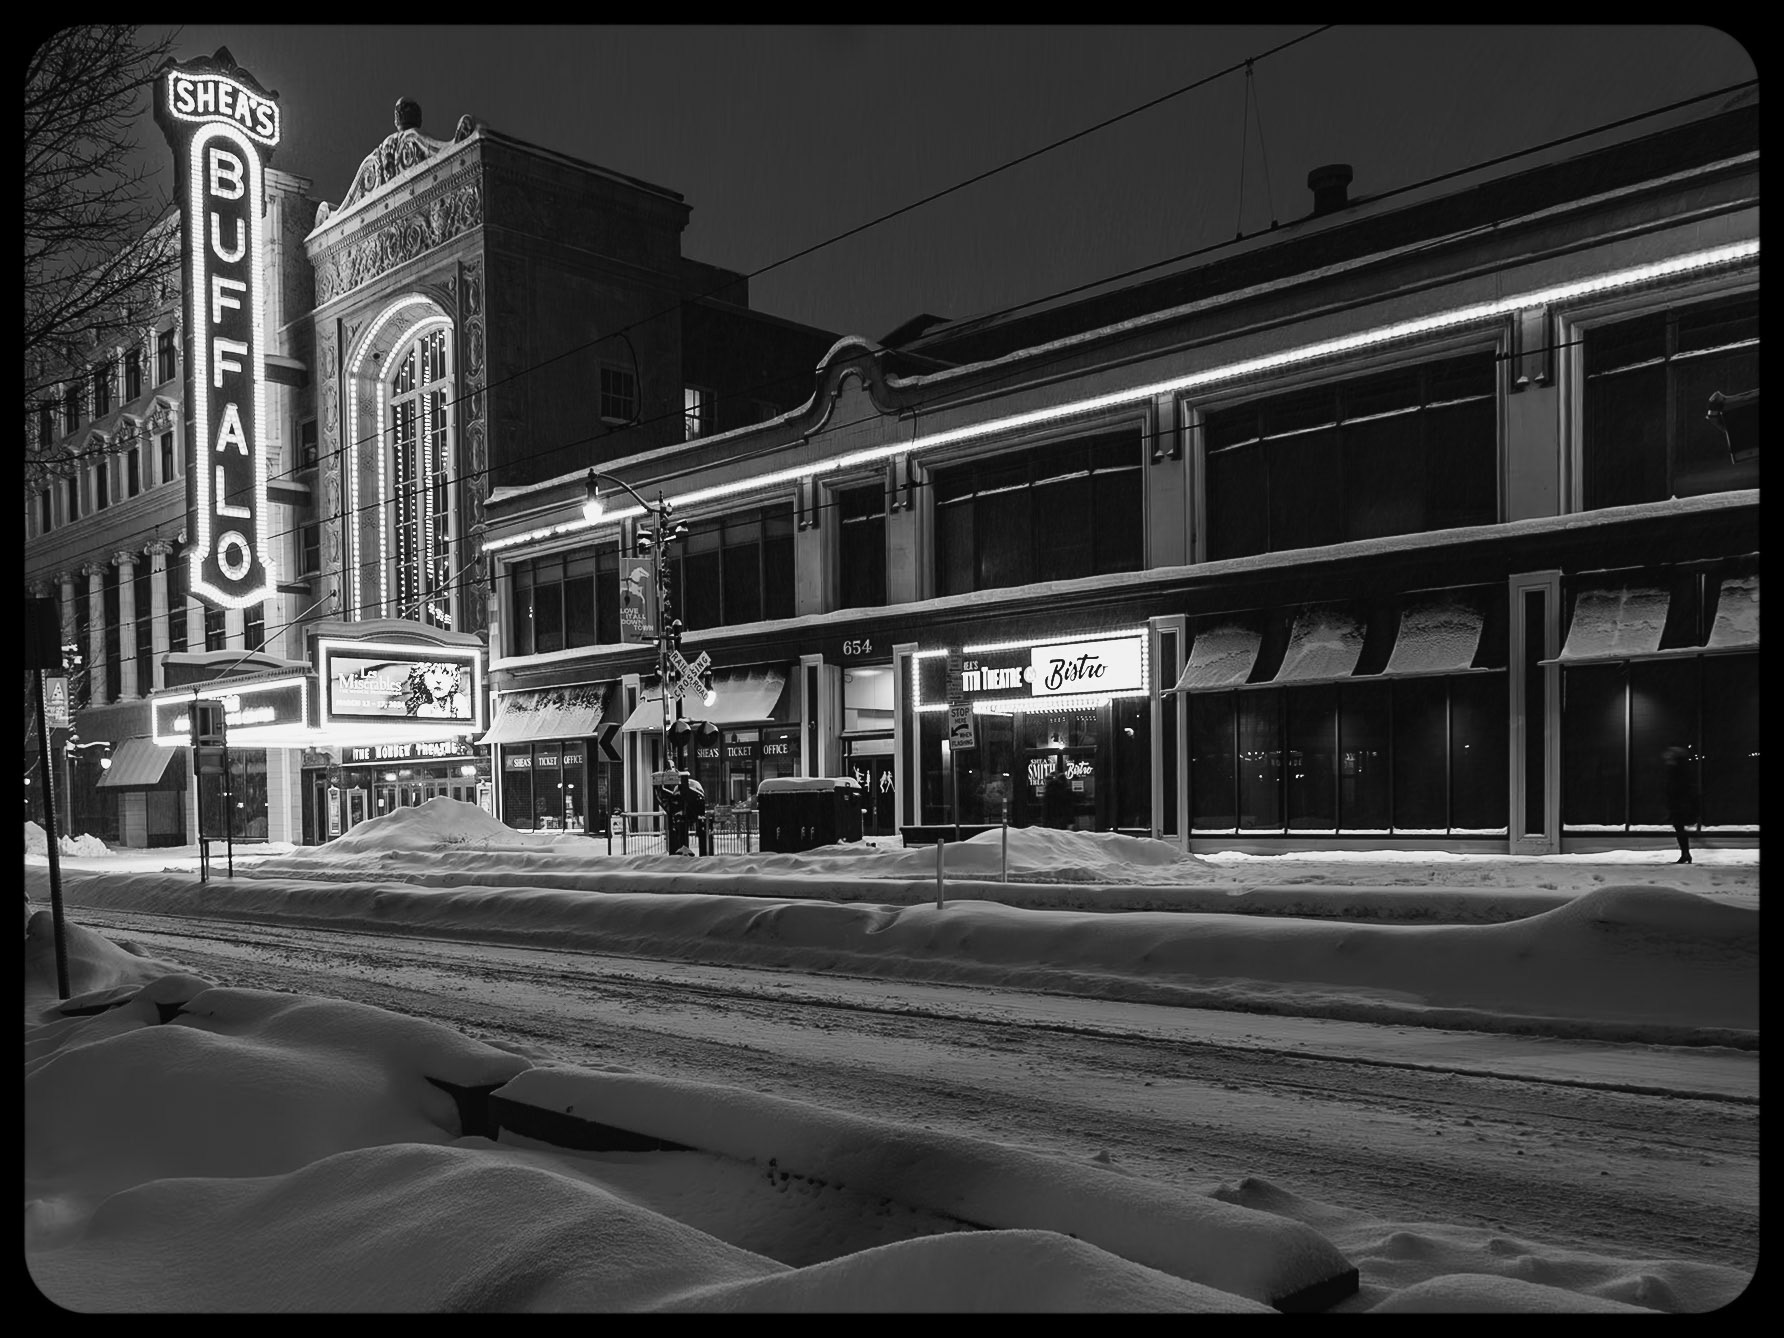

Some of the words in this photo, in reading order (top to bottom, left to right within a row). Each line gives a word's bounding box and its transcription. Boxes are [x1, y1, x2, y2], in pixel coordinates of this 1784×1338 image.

[176, 79, 274, 137] SHEA'S
[209, 147, 251, 581] BUFFALO
[843, 639, 873, 656] 654
[360, 666, 378, 679] Les
[673, 655, 709, 698] CROSSING
[981, 666, 1023, 691] THEATRE
[1045, 653, 1109, 691] Bistro
[951, 707, 970, 718] STOP
[696, 747, 720, 758] SHEA'S
[727, 746, 752, 757] TICKET
[763, 743, 788, 755] OFFICE
[951, 739, 974, 747] FLASHING
[353, 748, 370, 760] THE
[538, 756, 558, 766] TICKET
[563, 754, 583, 765] OFFICE
[1027, 763, 1056, 780] SMITH
[1064, 760, 1094, 780] Bistro
